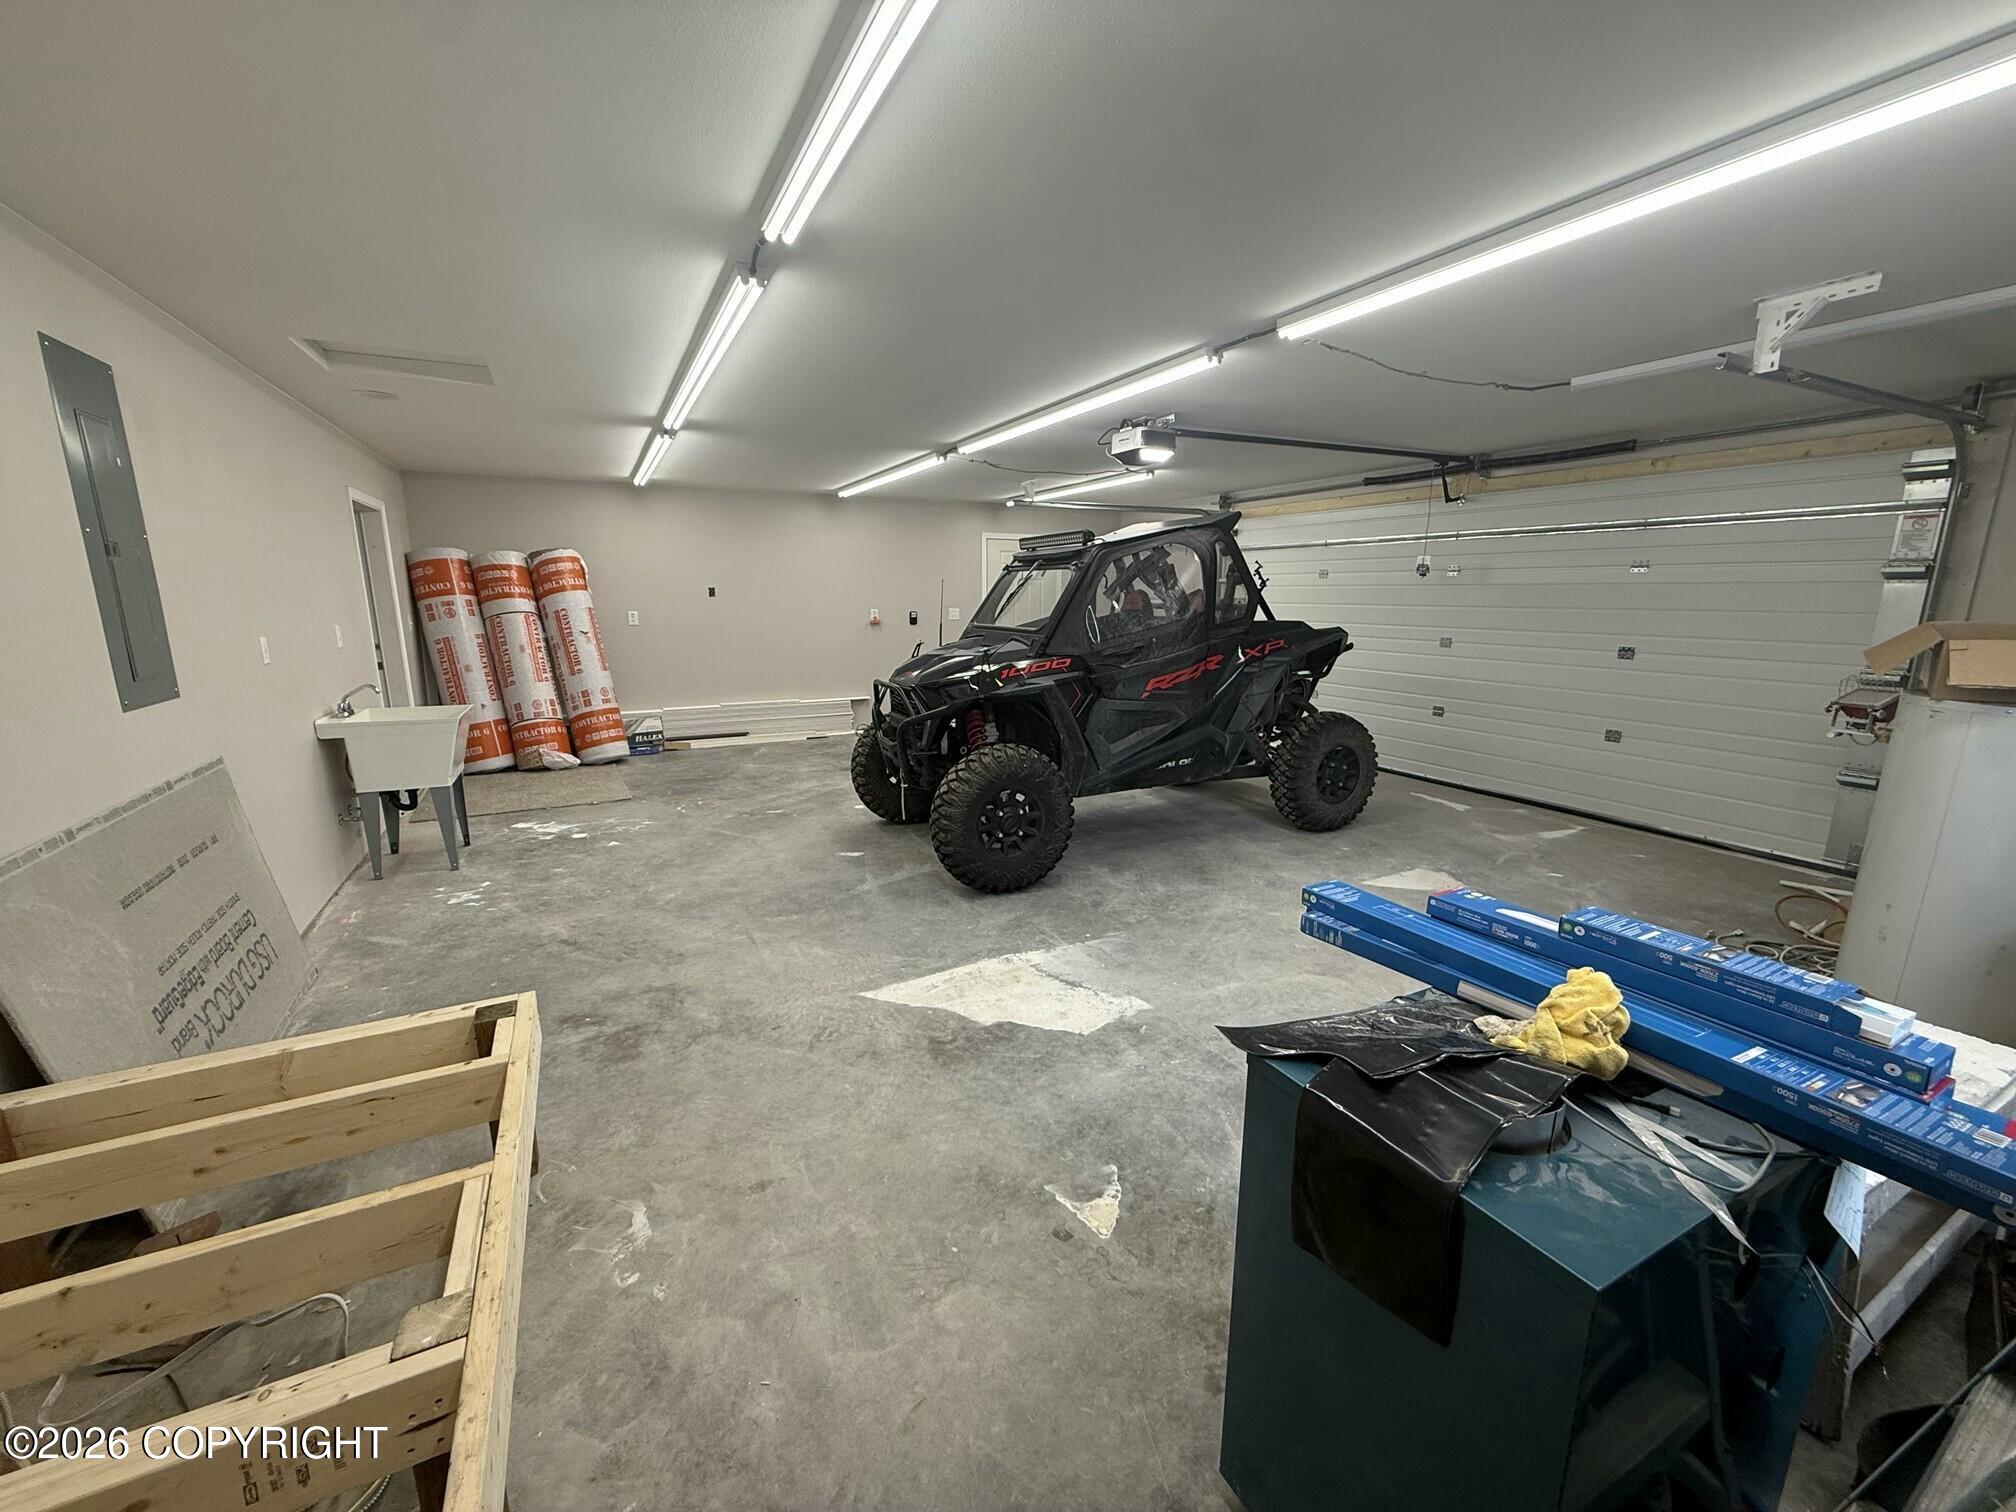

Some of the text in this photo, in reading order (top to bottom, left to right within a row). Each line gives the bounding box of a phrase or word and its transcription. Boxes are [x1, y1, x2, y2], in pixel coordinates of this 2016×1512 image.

[495, 616, 513, 676] CONTRACTOR
[560, 608, 580, 663] CONTRACTOR
[1243, 639, 1286, 660] XP
[437, 647, 457, 704] ONTRACTOR
[1000, 658, 1072, 679] 1000
[1140, 654, 1224, 699] RZR
[635, 734, 663, 743] HALEX
[227, 909, 258, 946] Cement
[207, 933, 236, 967] Board
[244, 932, 280, 981] USG
[171, 1019, 200, 1054] Brand
[1776, 1086, 1799, 1101] 1500
